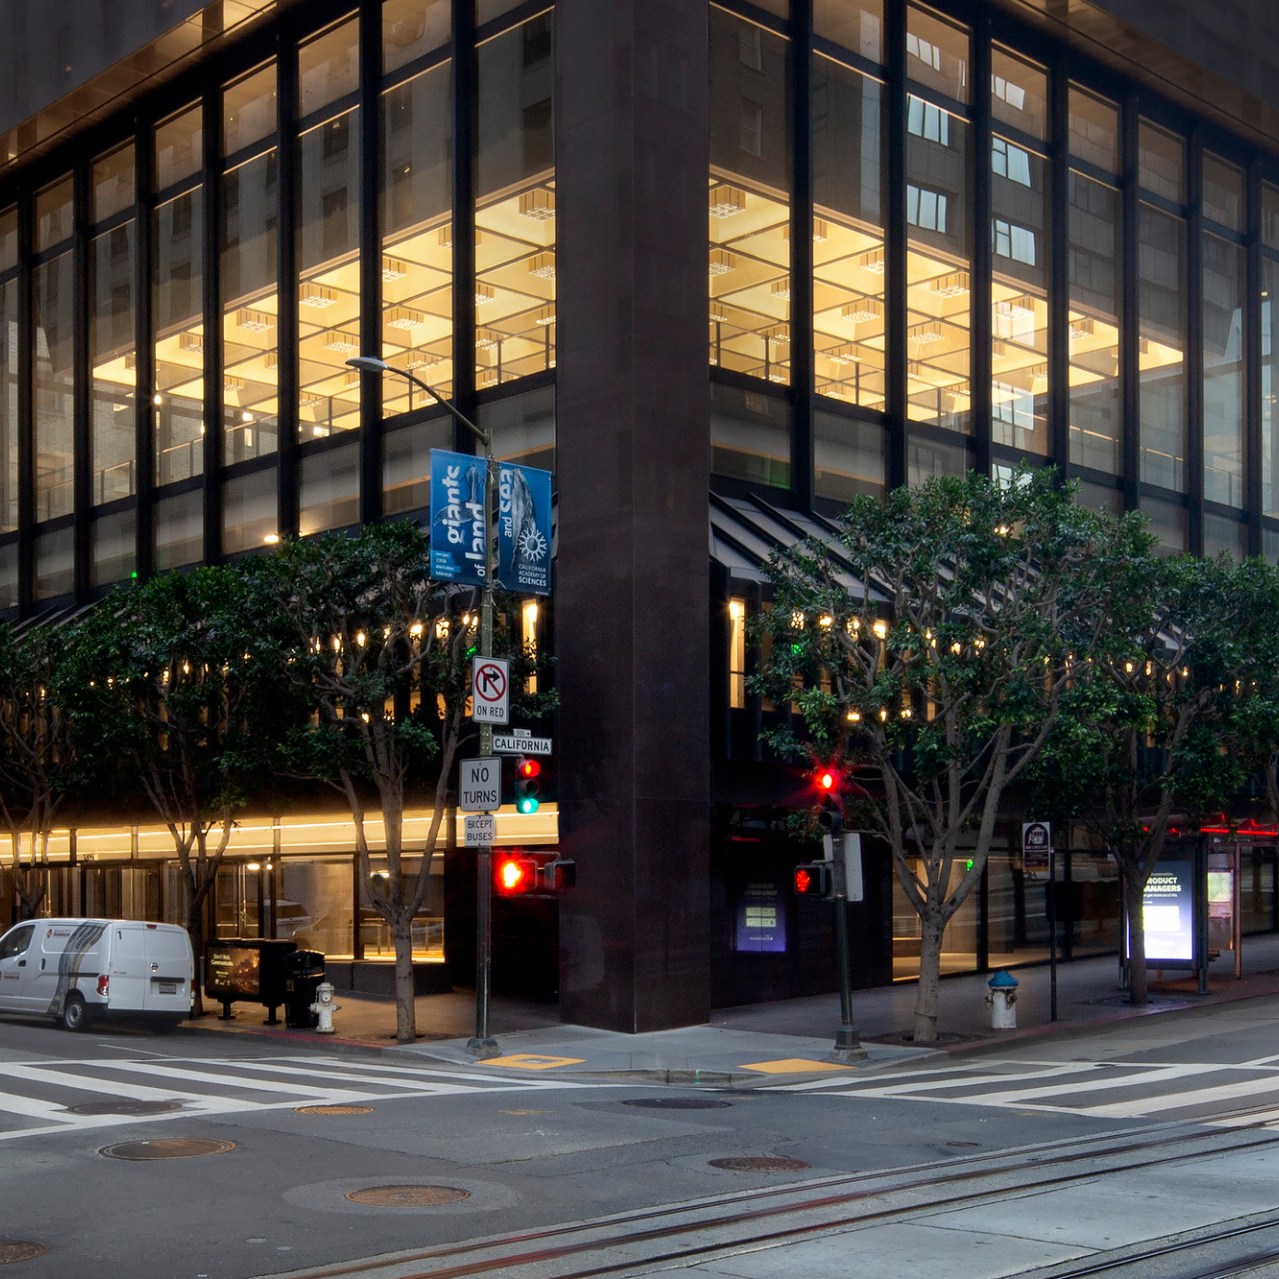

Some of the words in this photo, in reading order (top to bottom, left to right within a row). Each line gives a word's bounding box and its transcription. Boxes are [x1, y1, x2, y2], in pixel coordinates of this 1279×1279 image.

[499, 469, 513, 513] sea
[442, 465, 463, 545] giants
[465, 499, 485, 560] land
[501, 516, 513, 538] and
[474, 564, 486, 577] of
[518, 563, 547, 573] CALIFORNIA
[518, 570, 541, 578] ACADEMY
[518, 576, 547, 587] SCIENCES
[477, 705, 488, 716] ON
[490, 707, 504, 718] RED
[494, 738, 550, 752] CALIFORNIA
[471, 768, 489, 783] NO
[463, 790, 498, 804] TURNS
[467, 820, 493, 829] EXCEPT
[467, 832, 493, 841] BUSES
